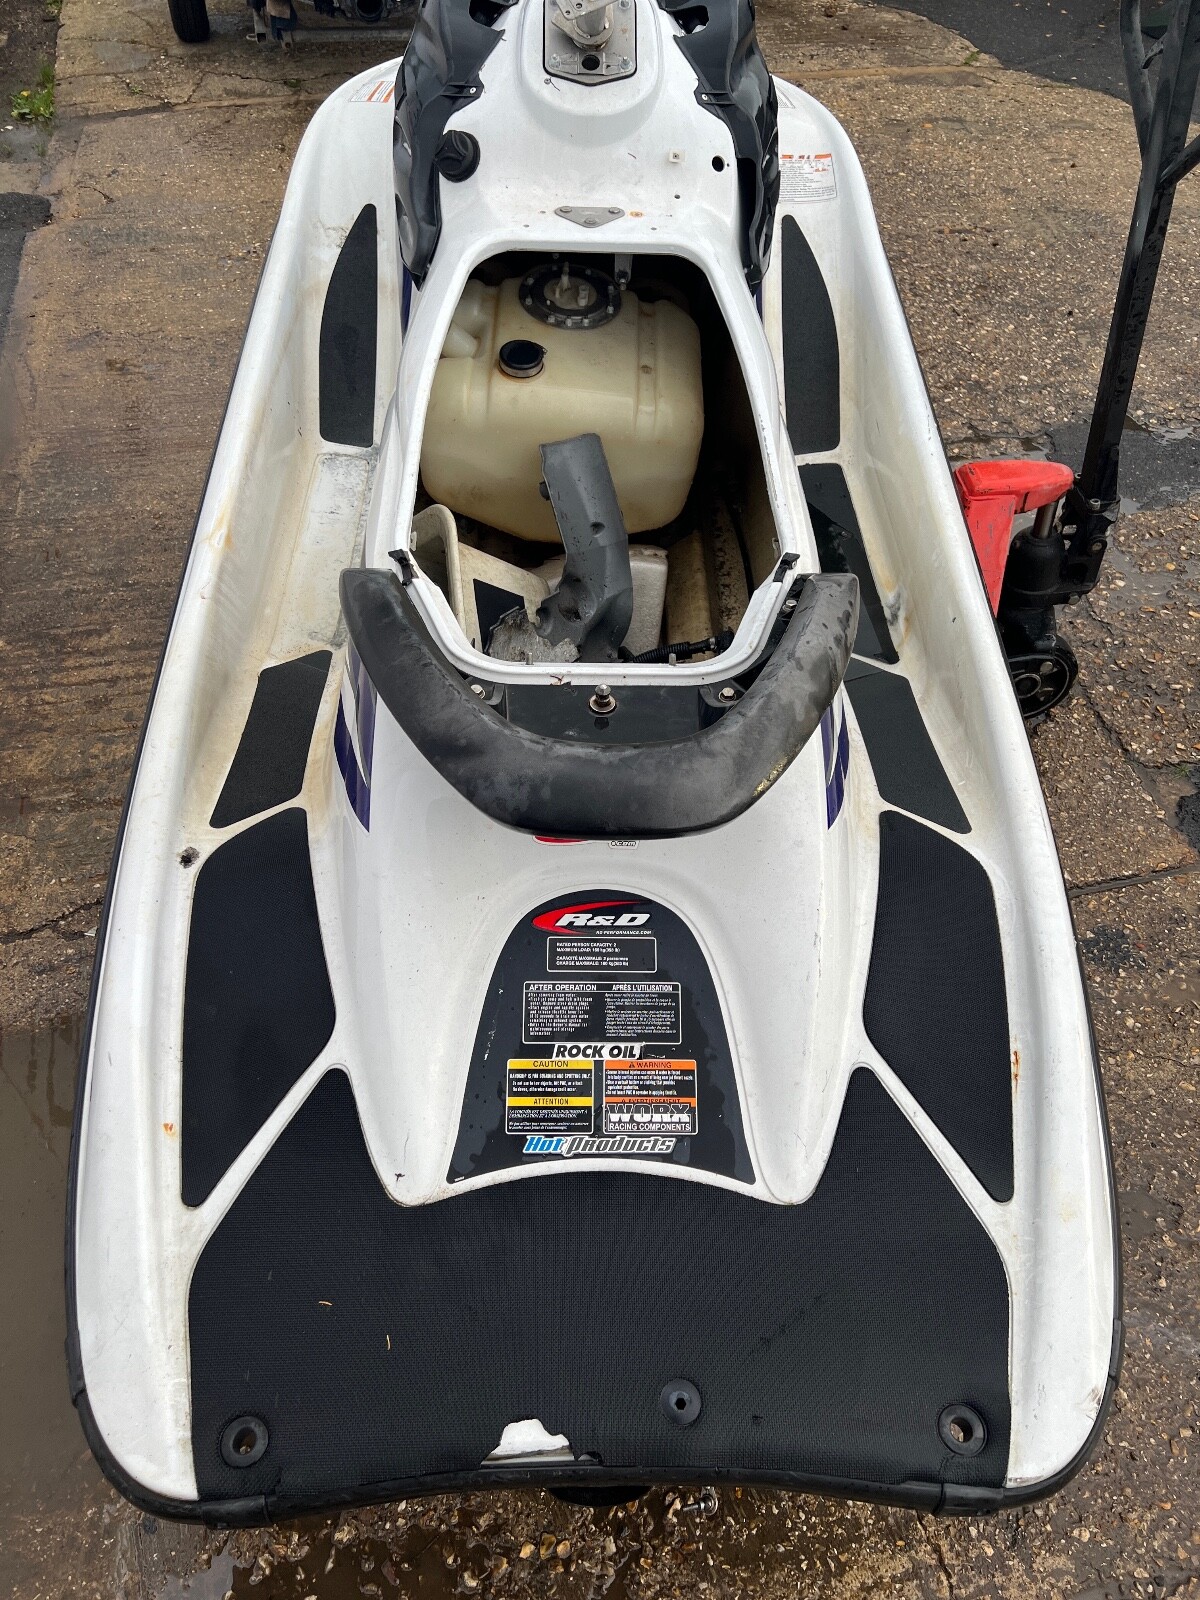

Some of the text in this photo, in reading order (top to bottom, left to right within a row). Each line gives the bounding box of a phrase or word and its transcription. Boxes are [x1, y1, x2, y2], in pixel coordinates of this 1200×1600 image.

[555, 914, 650, 926] R&D
[554, 1045, 636, 1058] ROCK OIL
[607, 1104, 690, 1122] WORX
[524, 1136, 676, 1156] Hot Products
